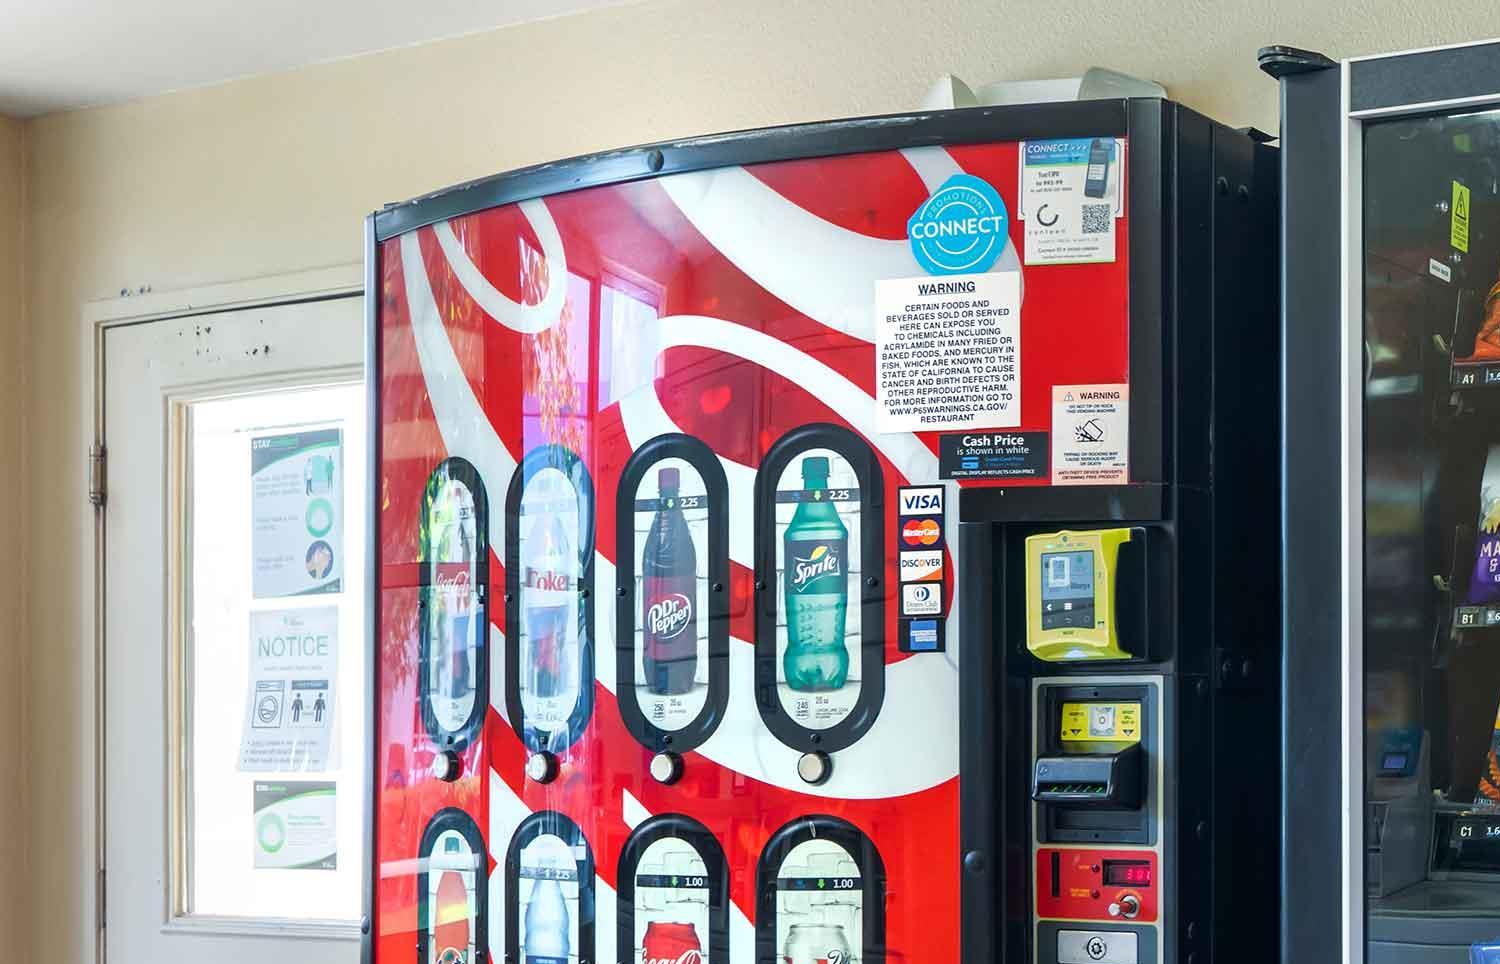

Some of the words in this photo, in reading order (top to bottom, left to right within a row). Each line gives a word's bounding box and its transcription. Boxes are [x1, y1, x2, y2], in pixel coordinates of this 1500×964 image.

[1027, 144, 1068, 153] CONNECT
[911, 215, 1004, 238] CONNECT
[918, 281, 976, 295] WARNING
[905, 304, 939, 312] CERTAIN
[942, 301, 970, 310] FOODS
[972, 300, 989, 308] AND
[887, 312, 935, 322] BEVERAGES
[938, 311, 959, 319] SOLD
[962, 310, 973, 318] OR
[976, 308, 1009, 317] SERVED
[900, 322, 920, 331] HERE
[924, 322, 940, 330] CAN
[943, 319, 975, 328] EXPOSE
[978, 318, 995, 326] YOU
[907, 330, 954, 340] CHEMICALS
[956, 328, 1001, 337] INCLUDING
[884, 339, 935, 351] ACRYLAMIDE
[938, 339, 945, 347] IN
[948, 338, 970, 346] MANY
[973, 337, 998, 345] FRIED
[1000, 336, 1012, 344] OR
[882, 352, 909, 360] BAKED
[963, 347, 1003, 355] MERCURY
[904, 360, 930, 368] WHICH
[951, 357, 982, 365] KNOWN
[882, 371, 906, 379] STATE
[909, 369, 919, 377] OF
[922, 367, 970, 376] CALIFORNIA
[986, 365, 1014, 373] CAUSE
[882, 380, 914, 388] CANCER
[936, 377, 960, 385] BIRTH
[962, 375, 1000, 384] DEFECTS
[1461, 373, 1475, 385] A1
[888, 389, 914, 398] OTHER
[916, 385, 979, 396] REPRODUCTIVE
[1080, 392, 1120, 400] WARNING
[884, 400, 900, 408] FOR
[903, 397, 925, 406] MORE
[928, 394, 984, 404] INFORMATION
[920, 414, 974, 423] RESTAURANT
[962, 436, 991, 447] Cash
[994, 435, 1024, 446] Price
[966, 447, 993, 455] shown
[996, 446, 1004, 454] in
[1006, 446, 1030, 454] white
[829, 489, 849, 500] 2.25
[680, 497, 699, 508] 2.25
[904, 495, 940, 509] VISA
[793, 552, 838, 584] Sprite
[902, 558, 940, 567] DISCOVER
[661, 600, 680, 618] Dr
[650, 605, 690, 637] Pepper
[257, 635, 328, 657] NOTICE
[684, 878, 703, 887] 1.00
[833, 879, 854, 889] 1.00
